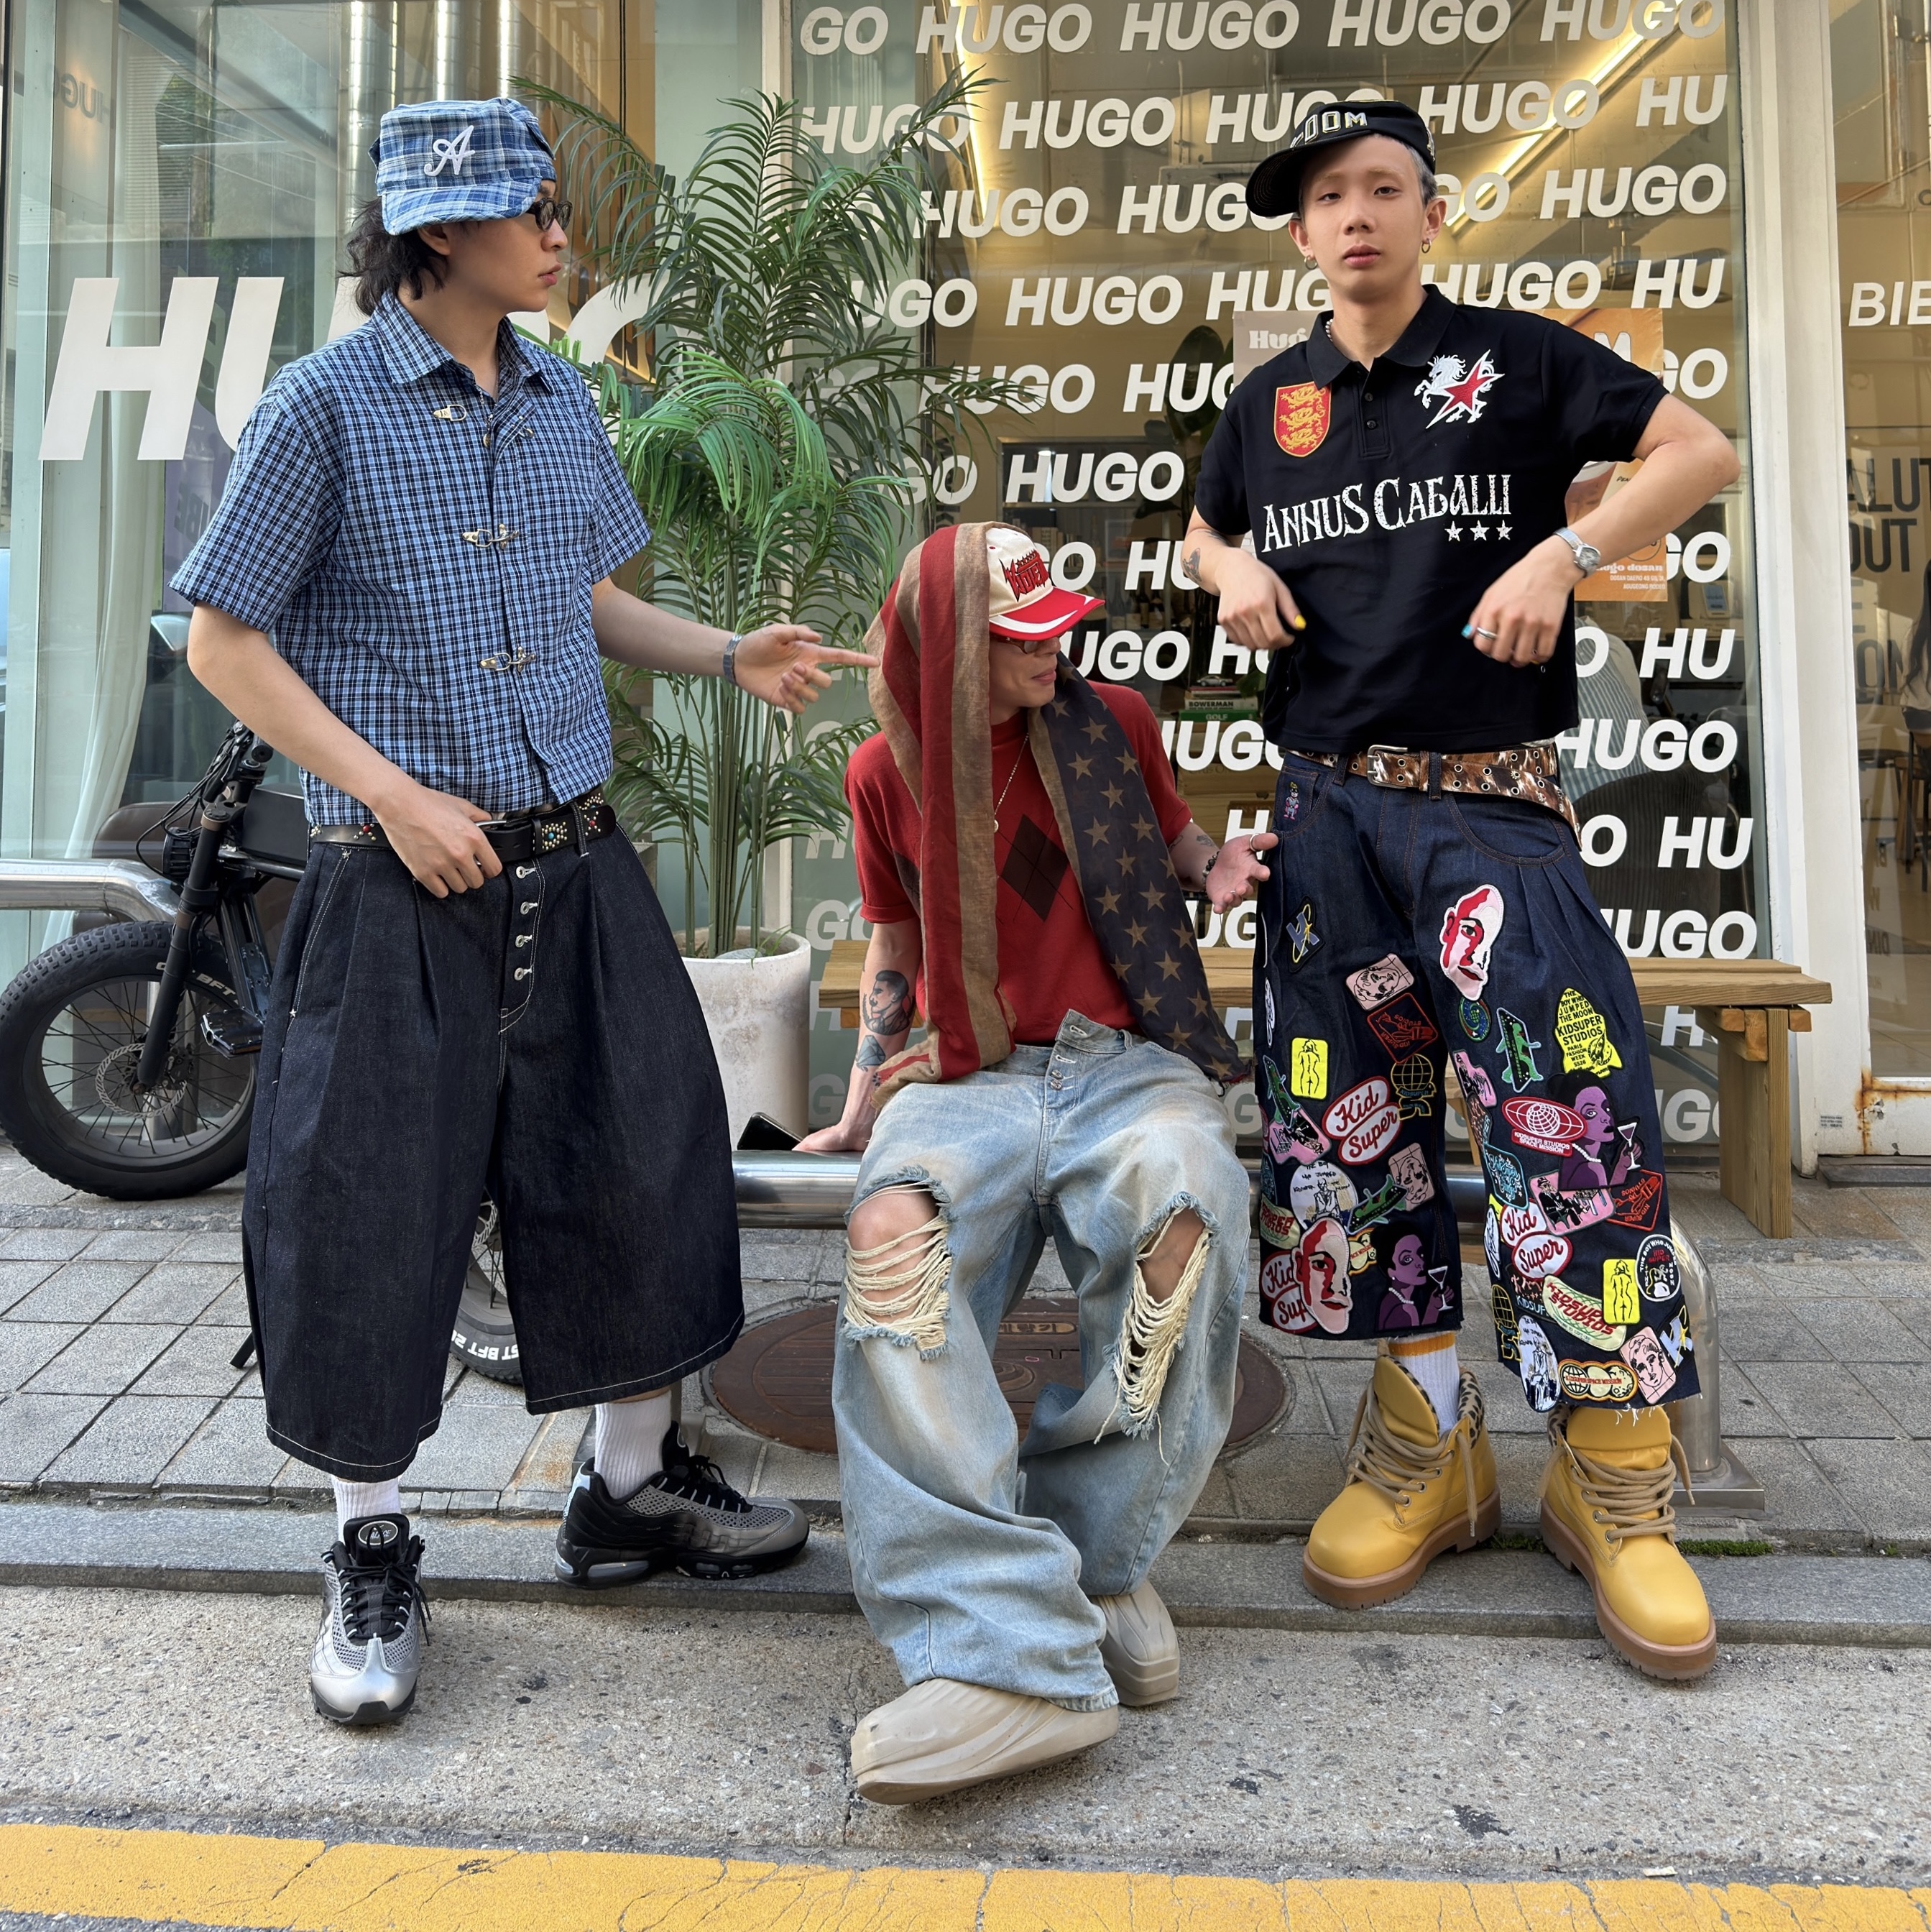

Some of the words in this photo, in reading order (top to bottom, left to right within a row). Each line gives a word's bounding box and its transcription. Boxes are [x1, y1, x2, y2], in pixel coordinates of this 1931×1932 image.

[800, 6, 889, 55] GO
[916, 2, 1092, 54] HUGO
[1120, 0, 1299, 51] HUGO
[1327, 0, 1511, 47] HUGO
[1539, 0, 1725, 42] HUGO
[799, 104, 972, 154] HUGO
[1000, 96, 1176, 150] HUGO
[1205, 88, 1384, 143] HU
[1417, 78, 1600, 134] HUGO
[1635, 74, 1728, 127] HU
[424, 125, 476, 176] A
[911, 186, 1089, 239] HUGO
[1539, 162, 1727, 220] HUGO
[847, 277, 977, 328] UGO
[1005, 275, 1184, 326] HUGO
[1205, 265, 1332, 321] HUG
[1421, 259, 1602, 310] HUGO
[1630, 257, 1725, 309] HU
[1249, 328, 1308, 349] Hug
[918, 363, 1095, 415] HUGO
[1123, 362, 1233, 413] HU
[1005, 451, 1185, 503] HUGO
[1261, 484, 1369, 553] ANNUS
[1125, 540, 1199, 591] HU
[1067, 630, 1190, 682] UGO
[1639, 627, 1735, 680] HU
[1189, 698, 1233, 707] BOWERMAN
[1161, 719, 1286, 772] UG
[1554, 718, 1738, 773] HUGO
[1657, 817, 1753, 870] HU
[196, 973, 236, 995] BFT
[1557, 1015, 1603, 1037] KIDSUPER
[1559, 1001, 1589, 1016] JUMPED
[1559, 1015, 1573, 1024] THE
[1573, 1008, 1593, 1020] MOON
[1562, 1026, 1603, 1046] STUDIOS
[1335, 1085, 1378, 1132] Kid
[1348, 1110, 1398, 1158] Super
[1514, 1131, 1542, 1144] KIDSUPER
[1543, 1141, 1570, 1150] STUDIOS
[1505, 1208, 1536, 1241] Kid
[1518, 1238, 1564, 1273] Super
[1279, 1299, 1306, 1325] Sup
[1516, 1295, 1548, 1316] KIDSU
[1547, 1282, 1603, 1320] KIDSUP
[1548, 1297, 1618, 1335] STUDIOS
[467, 1342, 499, 1361] BFT
